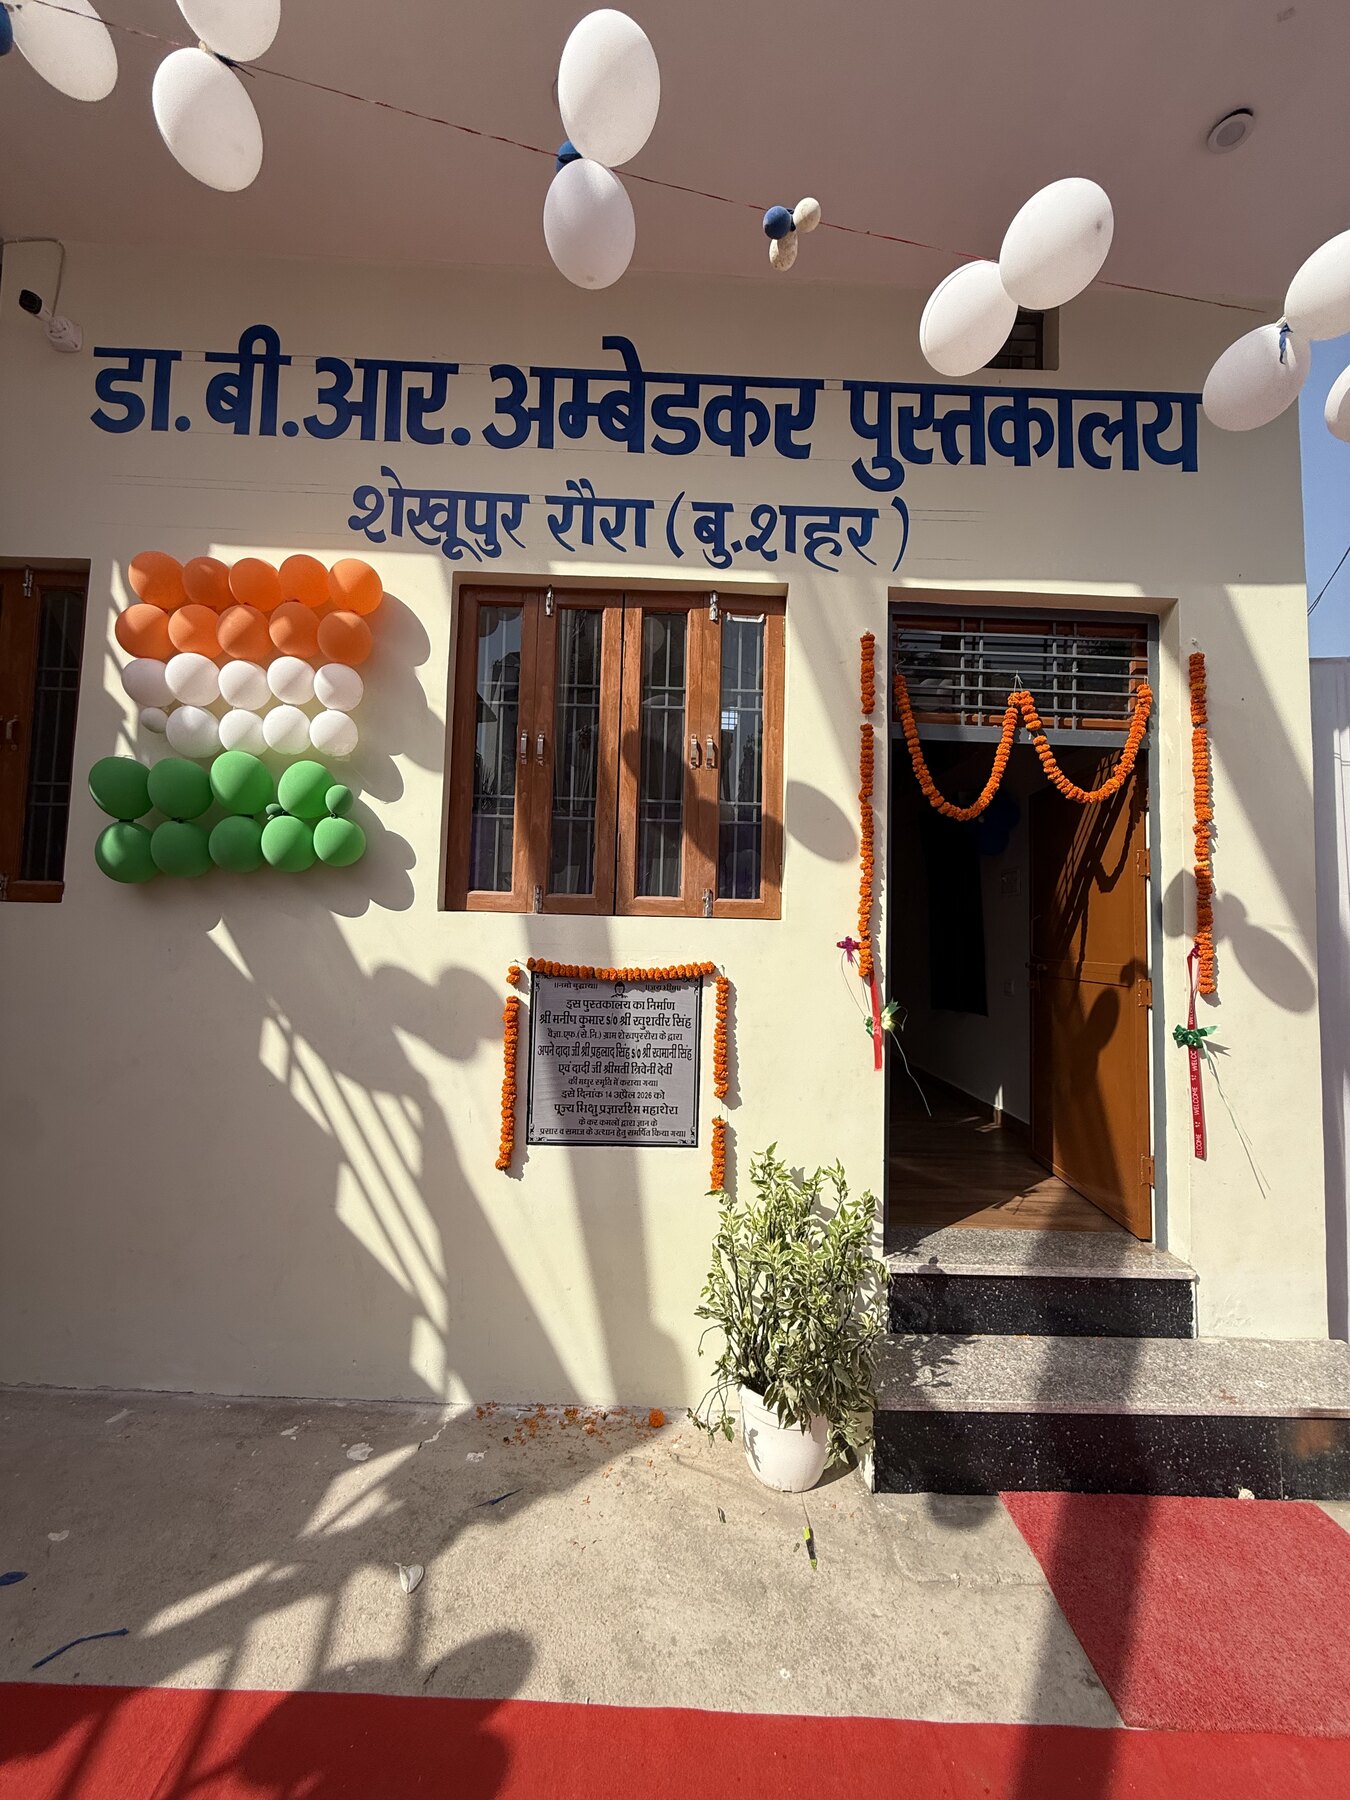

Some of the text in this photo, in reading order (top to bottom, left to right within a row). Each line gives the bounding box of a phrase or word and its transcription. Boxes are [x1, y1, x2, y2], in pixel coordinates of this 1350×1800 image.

[843, 379, 1202, 493] पुस्तकालय
[348, 465, 530, 563] शेखूपुर
[546, 478, 654, 554] रौरा
[566, 998, 675, 1012] इस पुस्तकालय का निर्माण
[539, 1010, 551, 1025] श्री
[553, 1011, 577, 1025] मनीष
[579, 1014, 605, 1028] कुमार
[619, 1012, 631, 1026] श्री
[672, 1013, 692, 1028] सिंह
[659, 1030, 666, 1040] के
[667, 1033, 682, 1041] द्वारा
[538, 1041, 554, 1056] अपने
[556, 1045, 570, 1057] दादा
[571, 1041, 580, 1056] जी
[581, 1041, 590, 1057] श्री
[615, 1042, 630, 1059] सिंह
[642, 1043, 651, 1058] श्री
[678, 1044, 692, 1060] सिंह
[558, 1061, 571, 1075] एवं
[572, 1061, 590, 1074] दादी
[591, 1061, 602, 1073] जी
[603, 1061, 630, 1074] श्रीमती
[657, 1062, 673, 1076] देवी
[568, 1076, 577, 1085] की
[620, 1079, 641, 1087] कराया
[561, 1088, 575, 1099] इसे
[577, 1088, 603, 1099] दिनांक
[653, 1089, 665, 1099] को
[1192, 1086, 1200, 1115] WELCOME
[554, 1103, 575, 1116] पूज्य
[578, 1116, 585, 1125] के
[621, 1119, 635, 1127] द्वारा
[586, 1126, 593, 1135] के
[616, 1127, 626, 1138] हेतु
[651, 1128, 669, 1137] किया
